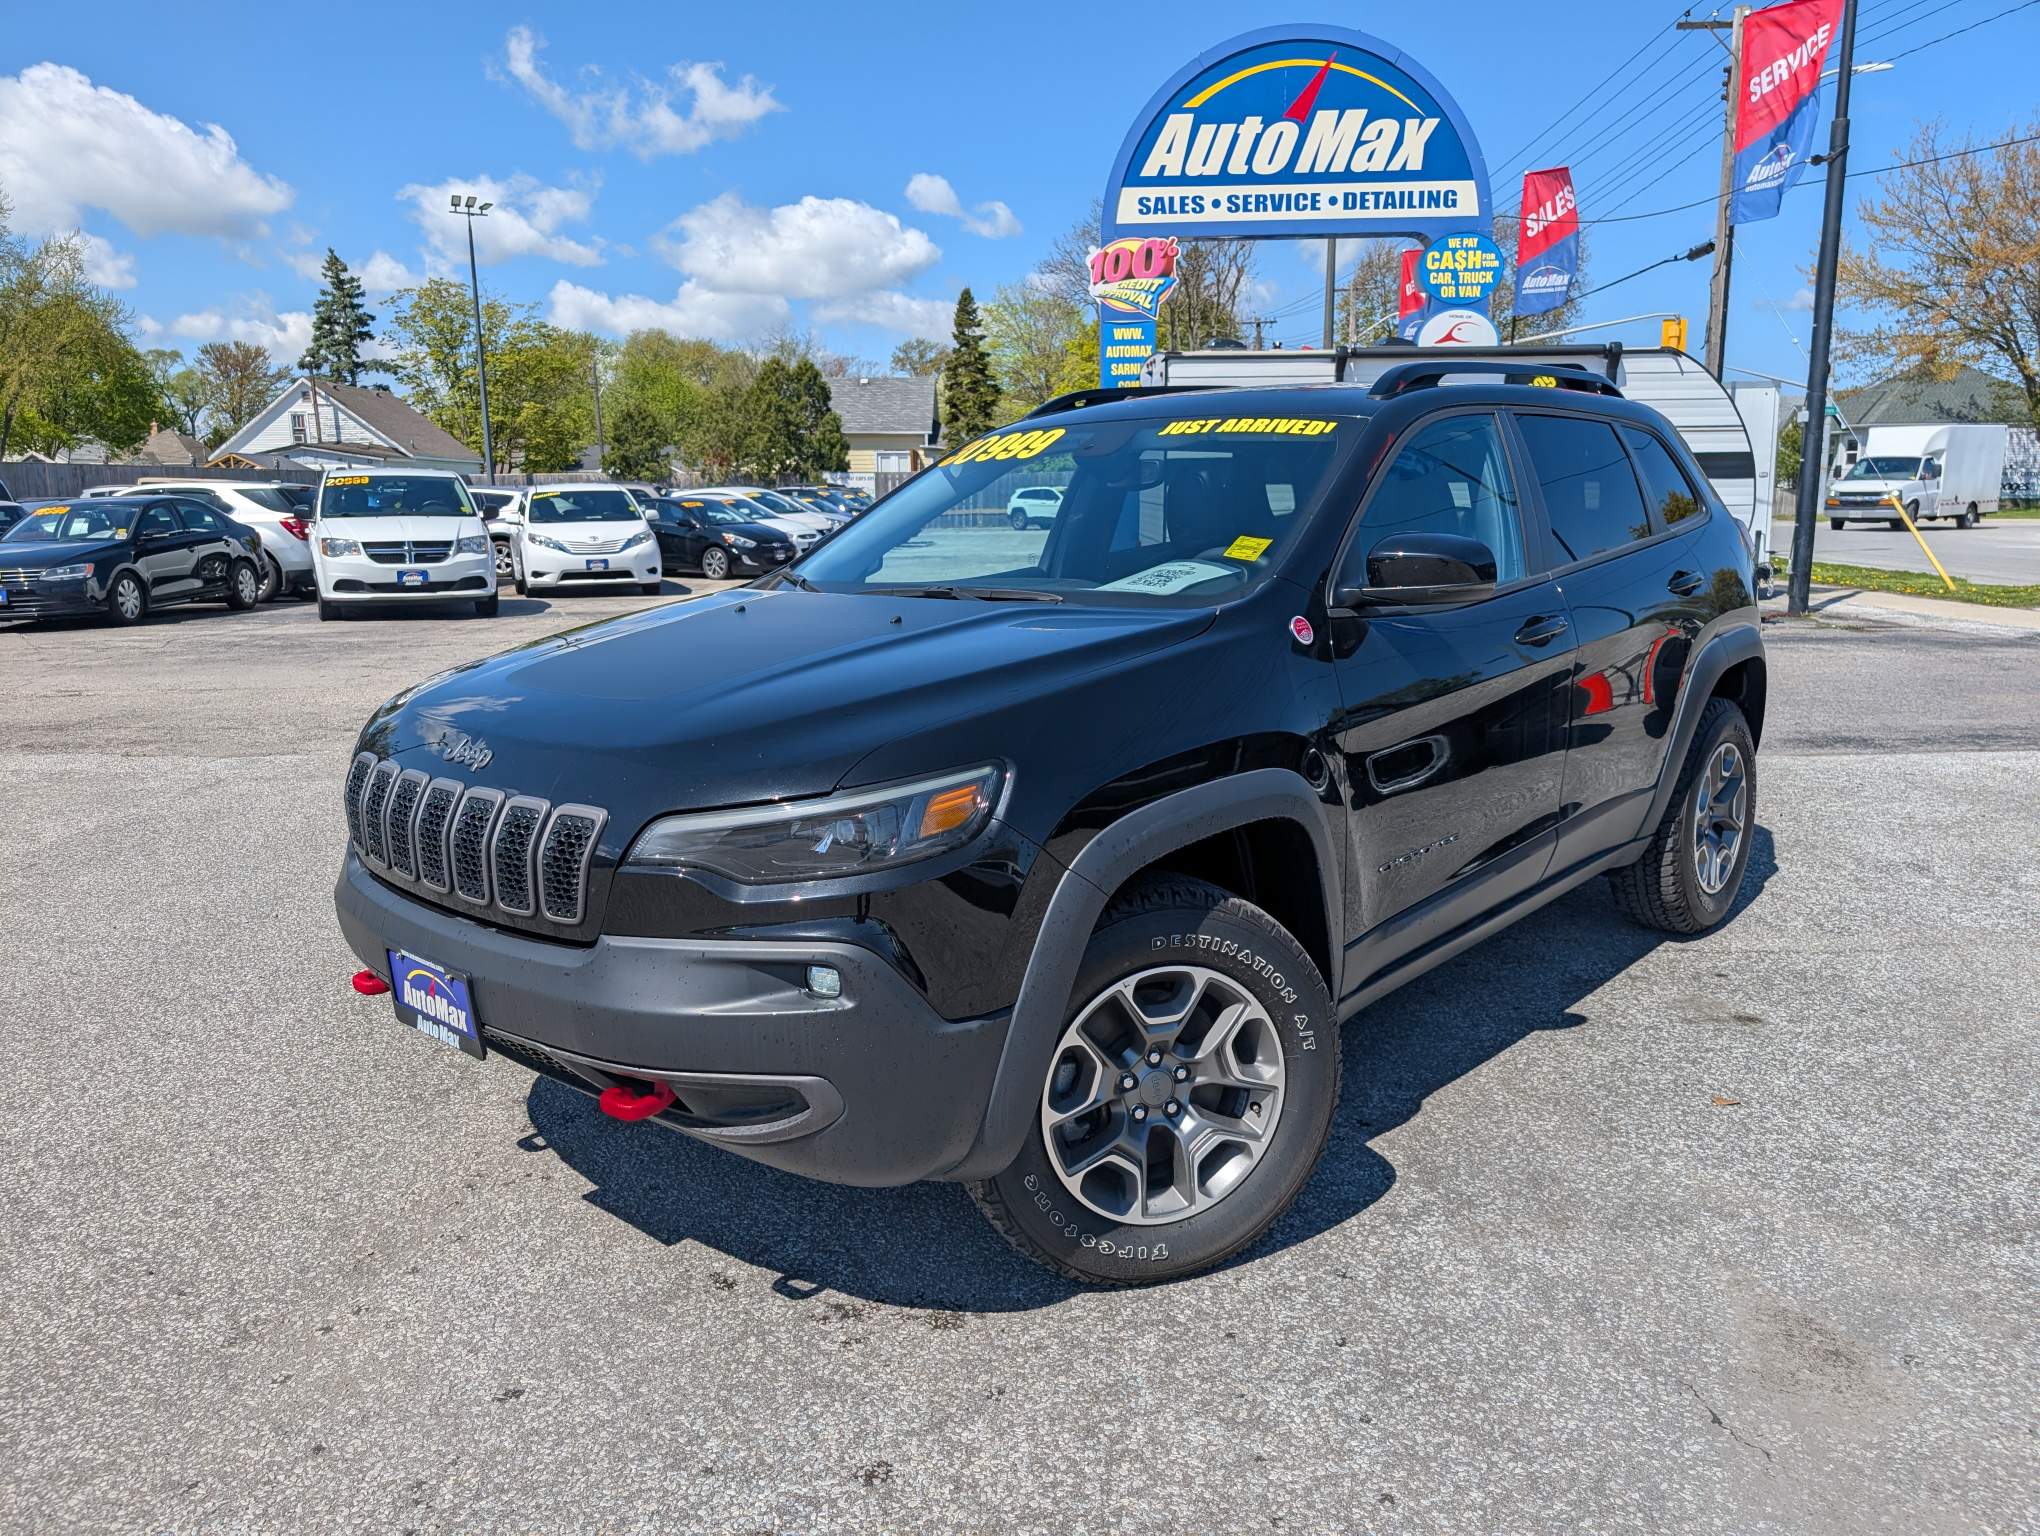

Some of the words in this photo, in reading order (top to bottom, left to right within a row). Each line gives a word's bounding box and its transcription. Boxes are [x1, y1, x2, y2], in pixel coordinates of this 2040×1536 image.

[1749, 23, 1831, 103] SERVICE
[1140, 109, 1440, 177] AutoMax
[1746, 152, 1796, 183] Autox
[1137, 195, 1205, 215] SALES
[1226, 192, 1321, 213] SERVICE
[1343, 189, 1458, 211] DETAILING
[1525, 185, 1576, 238] SALES
[1448, 238, 1461, 249] WE
[1463, 237, 1478, 248] PAY
[1091, 238, 1178, 286] 100%
[1426, 249, 1482, 271] CA$H
[1482, 260, 1499, 268] YOUR
[1430, 272, 1455, 285] CAR,
[1458, 271, 1494, 284] TRUCK
[1104, 288, 1152, 310] PPROVAL
[1441, 286, 1456, 298] OR
[1459, 285, 1481, 298] VAN
[1113, 327, 1145, 340] WWW.
[1106, 345, 1152, 358] AUTOMAX
[1111, 363, 1140, 376] SARNI
[1158, 419, 1221, 436] JUST
[1214, 418, 1338, 436] ARRIVED!
[443, 738, 494, 772] Jeep
[1151, 934, 1298, 1004] DESTINATION
[1294, 1013, 1317, 1051] A/T
[1024, 1173, 1168, 1262] Firestone
